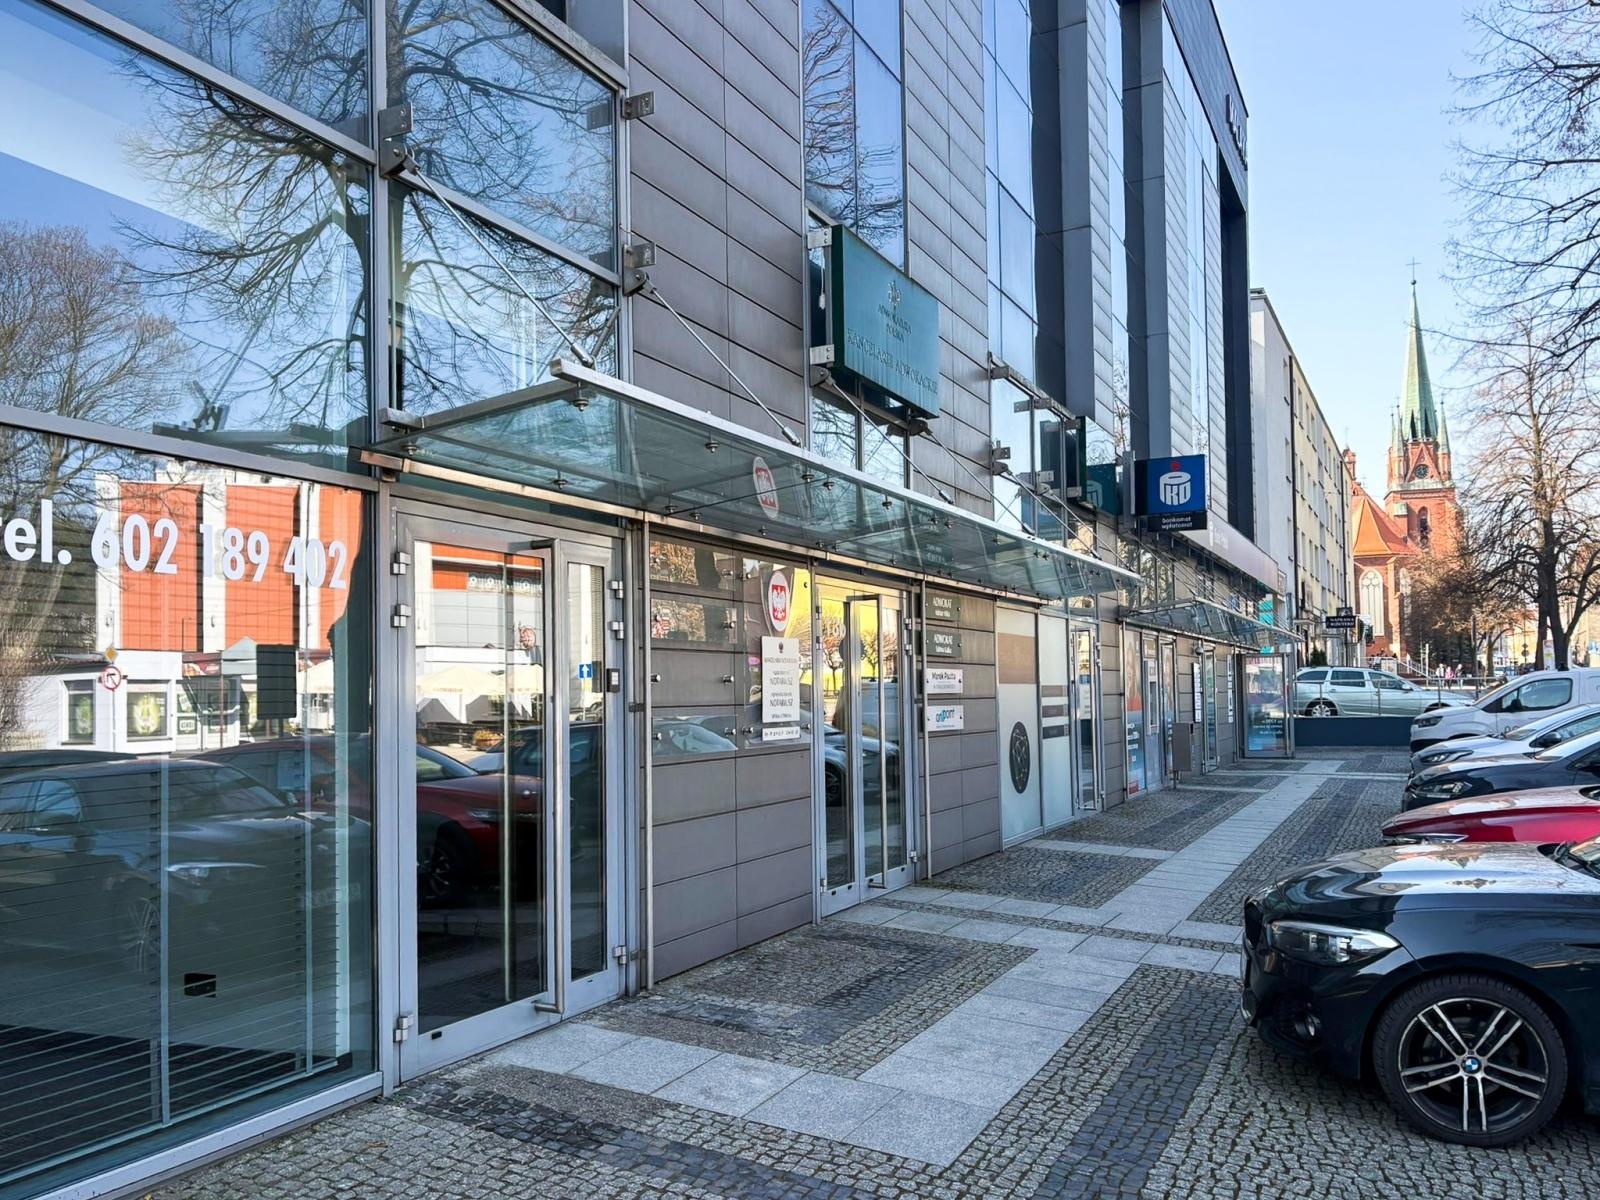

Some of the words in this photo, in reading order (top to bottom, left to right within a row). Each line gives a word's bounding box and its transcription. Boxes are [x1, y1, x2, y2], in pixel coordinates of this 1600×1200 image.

[0, 498, 72, 565] el.
[91, 510, 179, 575] 602
[199, 523, 270, 582] 189
[283, 535, 347, 589] 402
[933, 597, 953, 609] ADWOKAT
[933, 633, 953, 645] ADWOKAT
